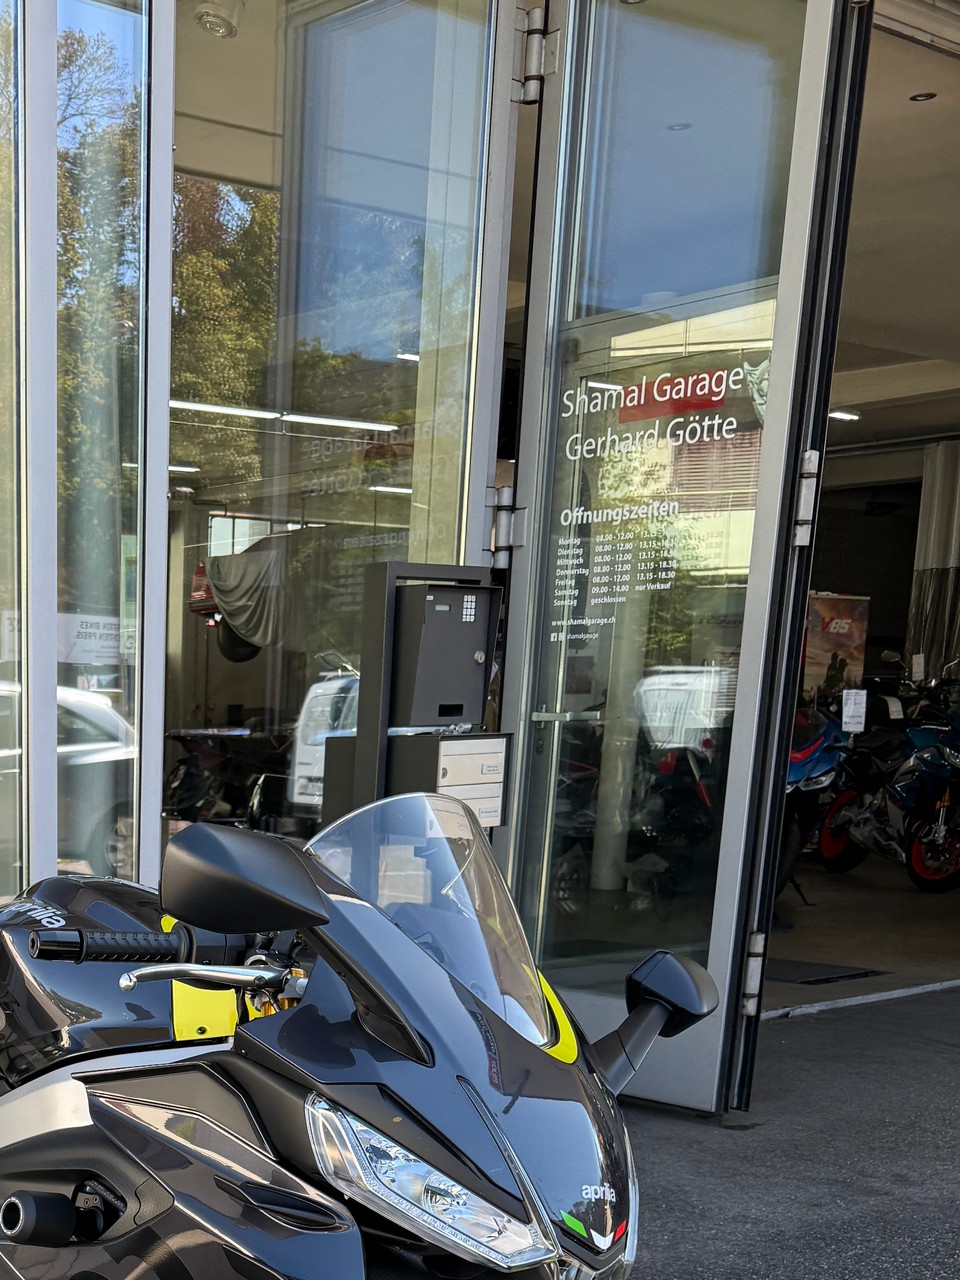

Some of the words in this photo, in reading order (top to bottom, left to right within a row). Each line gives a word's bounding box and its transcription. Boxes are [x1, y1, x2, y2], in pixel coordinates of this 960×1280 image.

[561, 375, 646, 418] Shamal
[653, 366, 744, 401] Garage
[565, 420, 660, 461] Gerhard
[665, 415, 737, 447] Götte
[558, 537, 581, 546] Montag
[595, 534, 612, 542] 08.00
[617, 532, 634, 540] 12.00
[558, 548, 584, 556] Dienstag
[595, 544, 612, 552] 08.00
[616, 542, 633, 550] 12.00
[640, 540, 656, 548] 13.15
[556, 557, 584, 566] Mittwoch
[594, 554, 611, 563] 08.00
[616, 553, 632, 561] 12.00
[638, 551, 656, 560] 13.15
[556, 568, 590, 576] Donnerstag
[594, 565, 610, 573] 08.00
[614, 564, 631, 572] 12.00
[638, 562, 654, 570] 13.15
[555, 578, 576, 586] Freitag
[592, 576, 609, 584] 08.00
[614, 574, 630, 582] 12.00
[636, 572, 654, 580] 13.15
[658, 571, 676, 579] 18.30
[554, 588, 579, 597] Samstag
[592, 586, 608, 594] 09.00
[612, 584, 630, 592] 14.00
[634, 584, 646, 592] nur
[646, 581, 672, 590] Verkauf
[554, 598, 578, 607] Sonntag
[590, 596, 626, 606] geschlossen
[552, 616, 616, 626] www.shamalgarage.ch
[821, 616, 852, 633] V85
